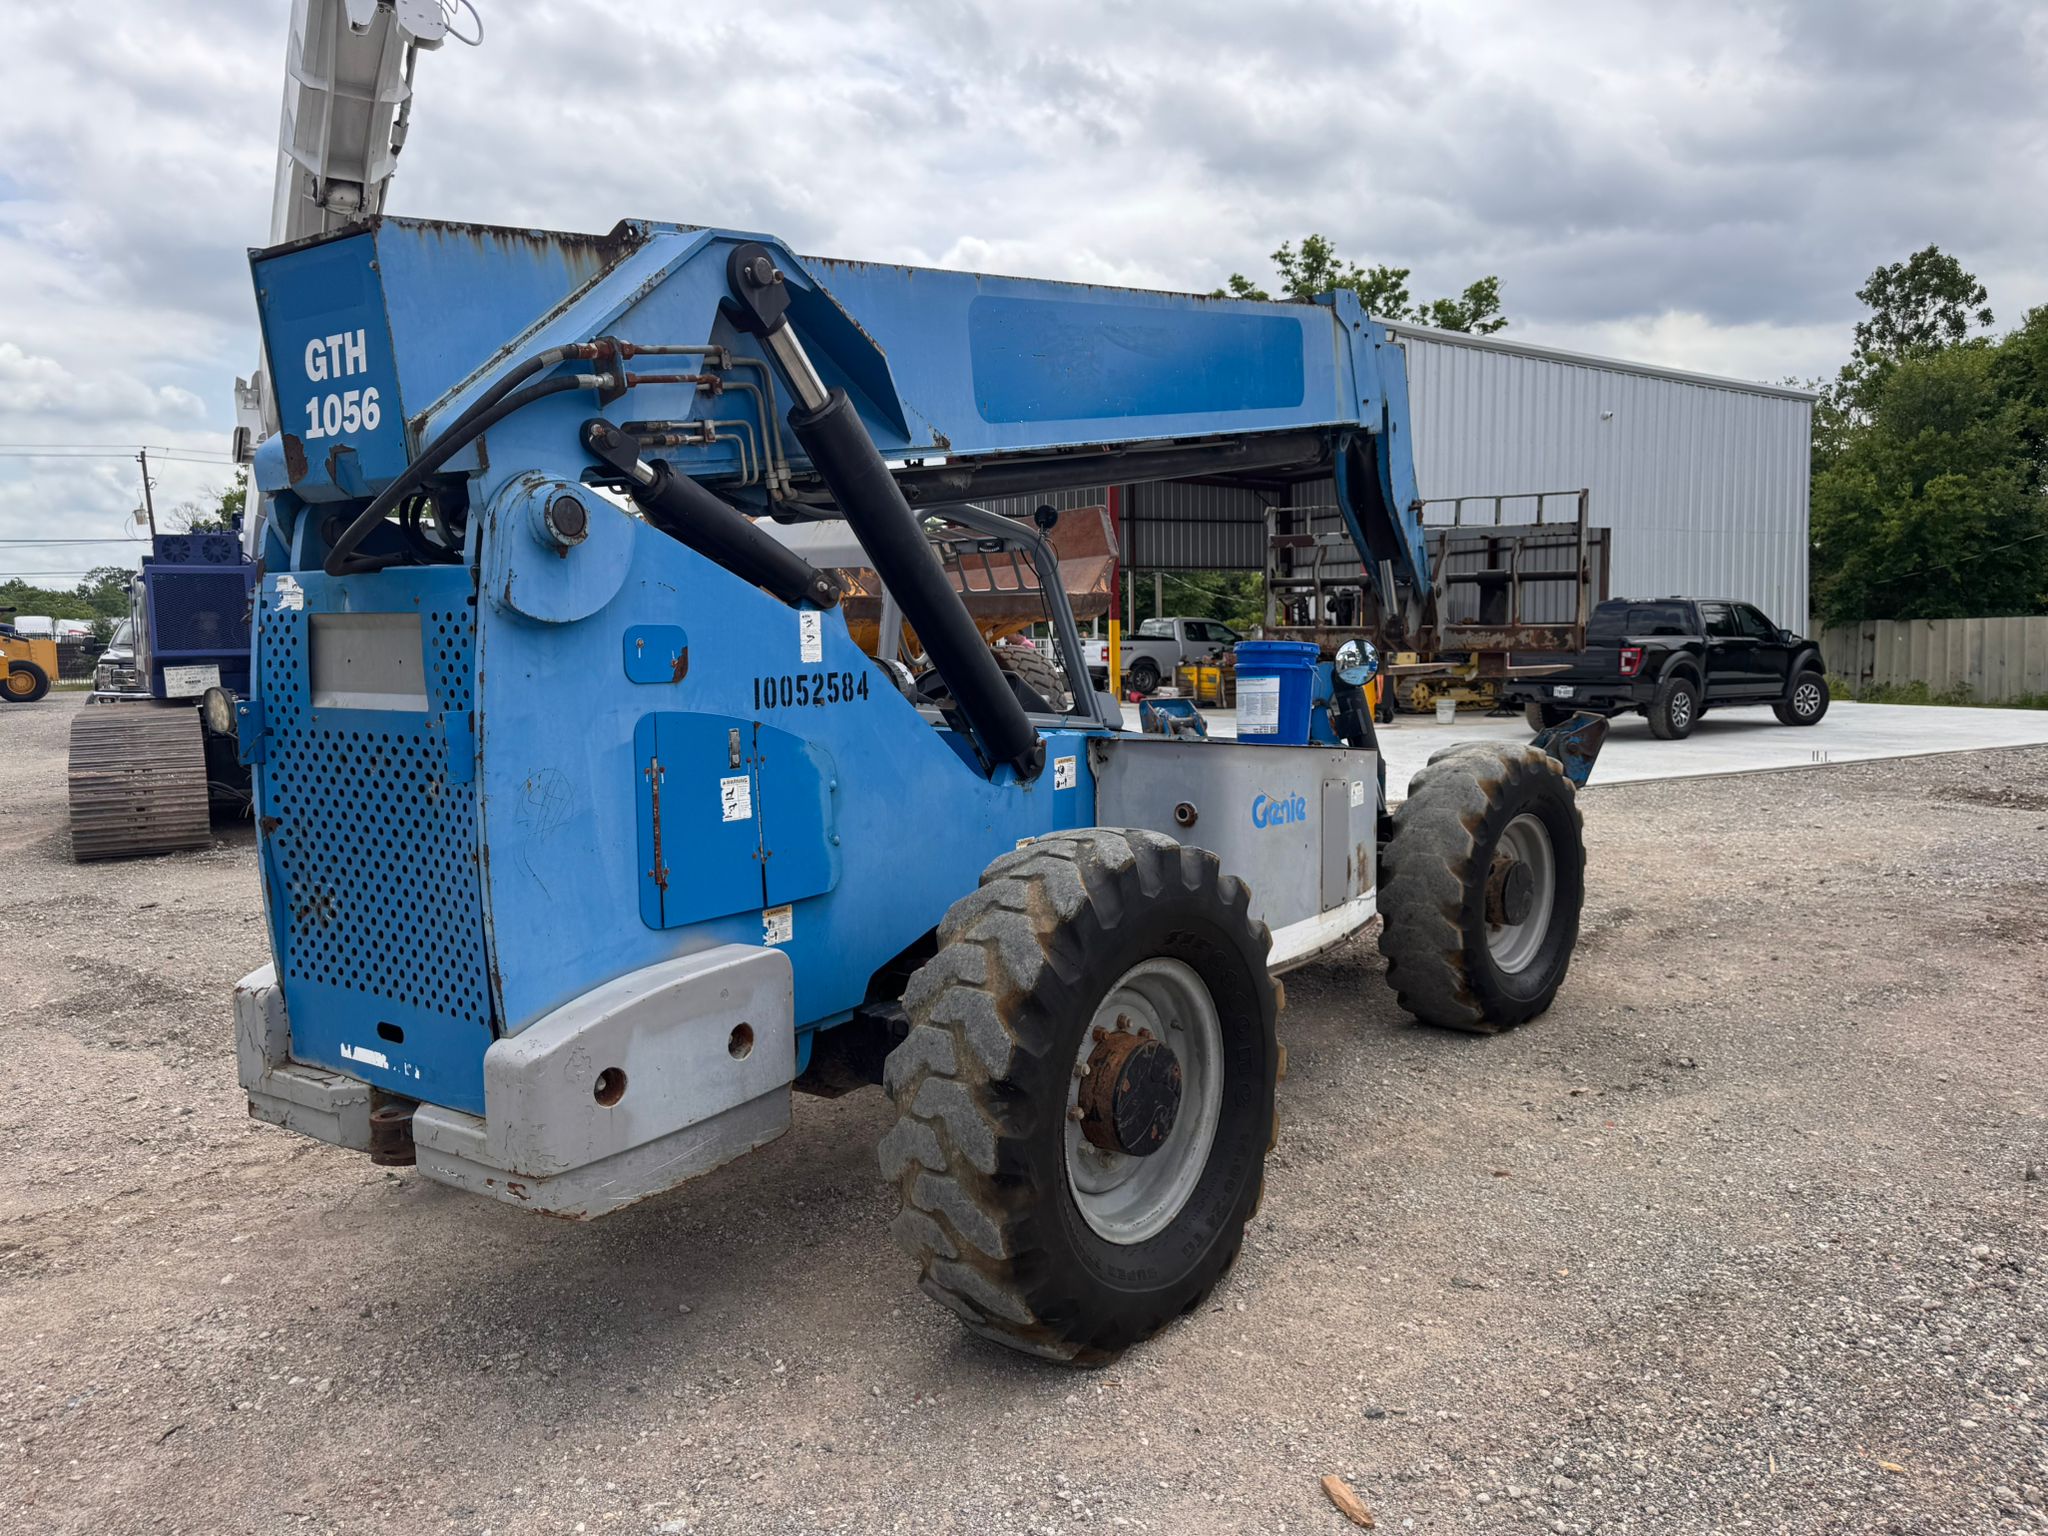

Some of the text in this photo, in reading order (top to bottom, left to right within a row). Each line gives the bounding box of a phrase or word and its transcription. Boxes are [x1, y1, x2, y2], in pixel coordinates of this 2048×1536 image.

[304, 329, 367, 382] GTH
[305, 387, 380, 440] 1056
[754, 671, 869, 710] 10052584
[1251, 791, 1307, 829] Genie
